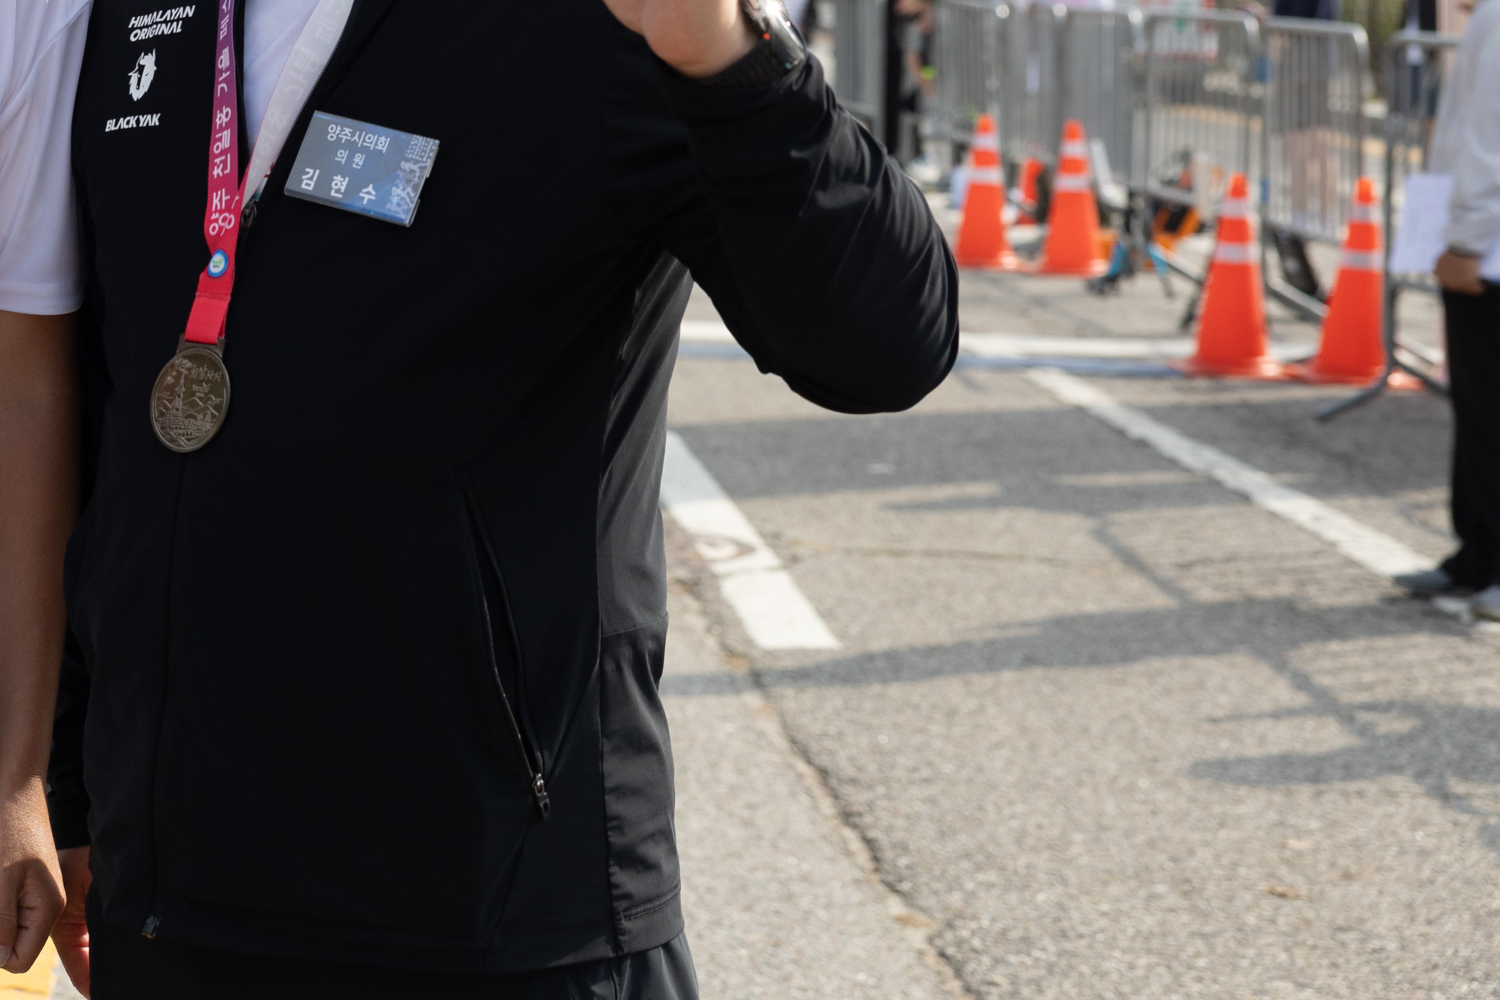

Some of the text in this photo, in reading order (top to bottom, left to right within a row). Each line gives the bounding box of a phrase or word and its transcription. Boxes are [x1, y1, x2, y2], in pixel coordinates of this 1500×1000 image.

[128, 5, 196, 28] HIMALAYAN
[129, 20, 184, 42] ORIGINAL
[217, 45, 231, 97] 가을
[213, 105, 232, 178] 천일홍
[327, 123, 391, 154] 양주시의회
